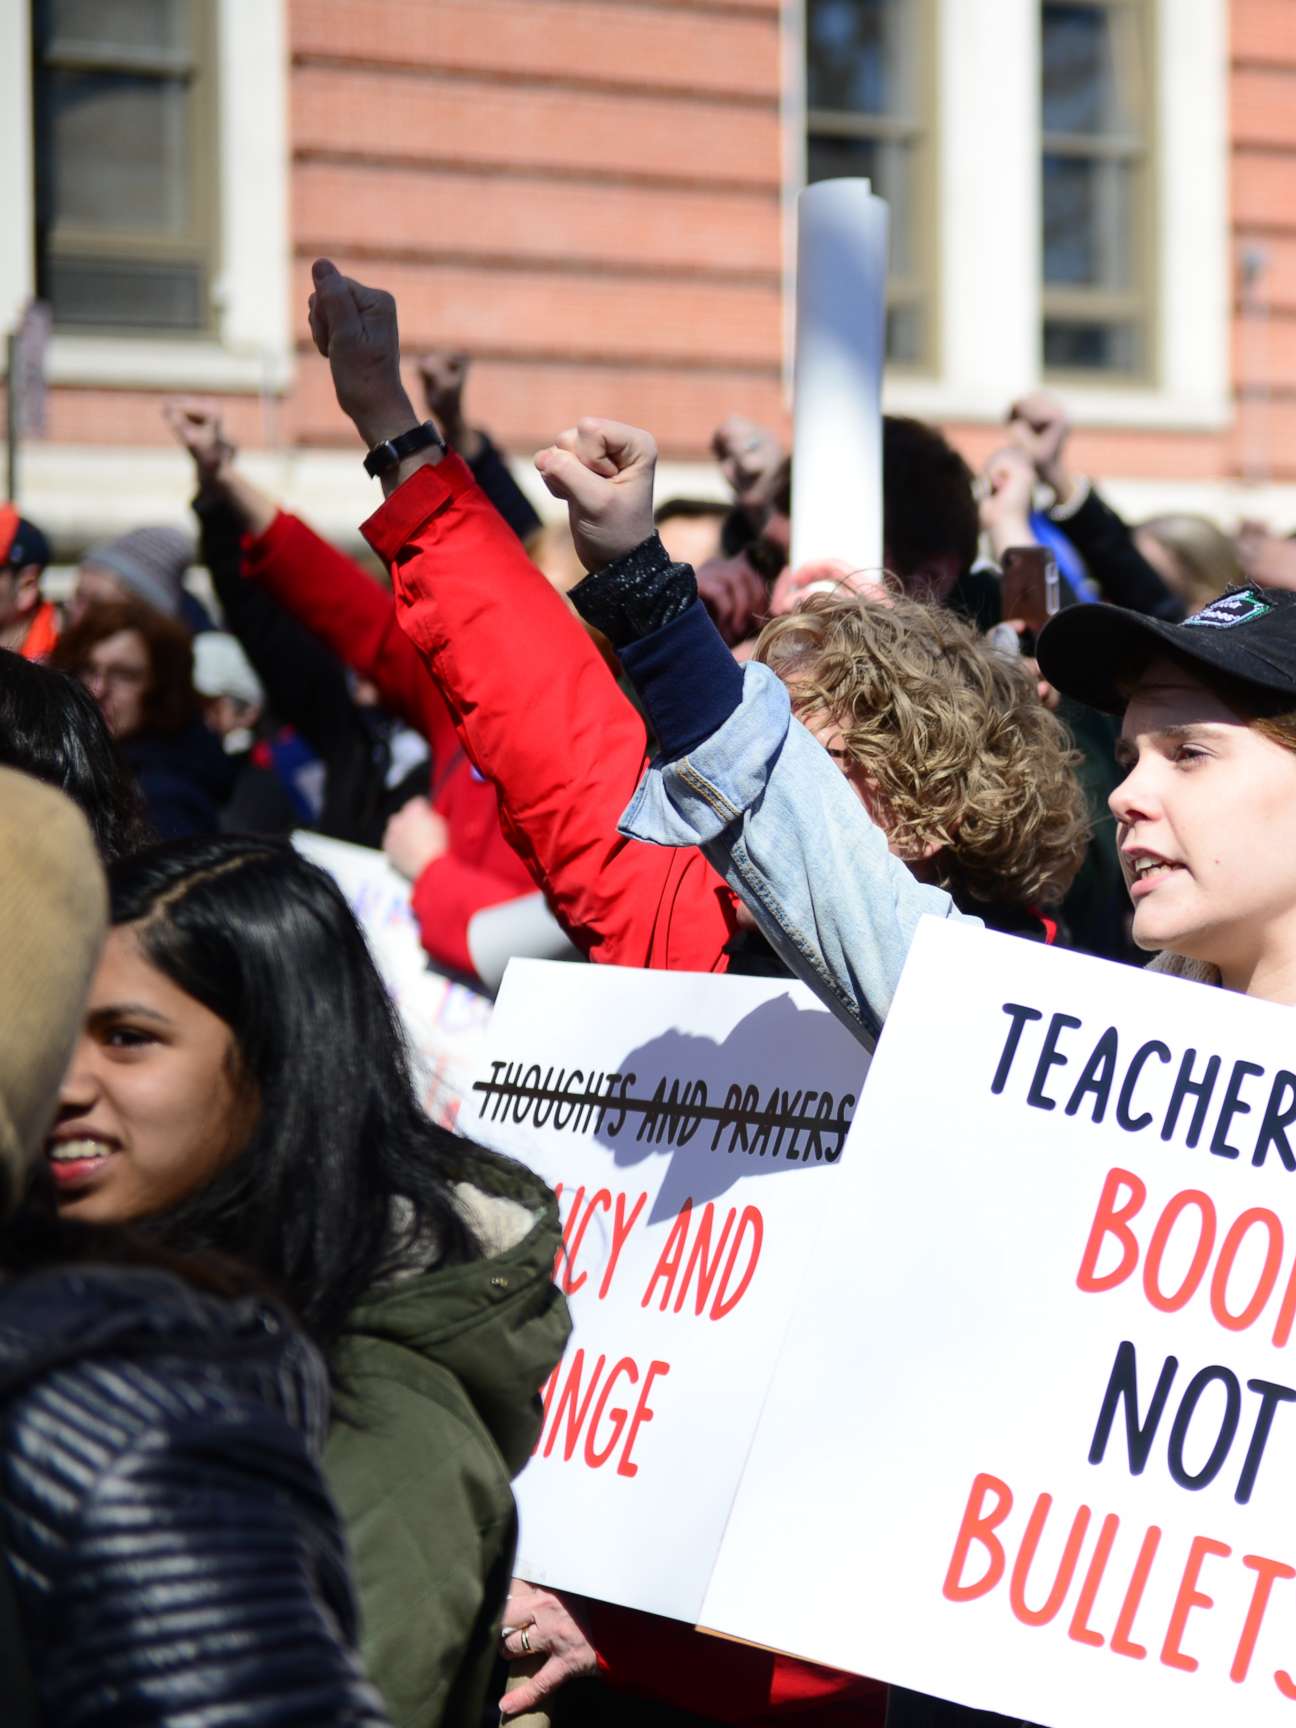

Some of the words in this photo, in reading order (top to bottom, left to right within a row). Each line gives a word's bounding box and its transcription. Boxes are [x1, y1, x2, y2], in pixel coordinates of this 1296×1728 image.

[478, 1061, 637, 1137] THOUGHTS
[635, 1076, 708, 1147] AND
[710, 1083, 856, 1163] PRAYERS
[552, 1182, 648, 1300] ICY
[640, 1195, 764, 1321] AND
